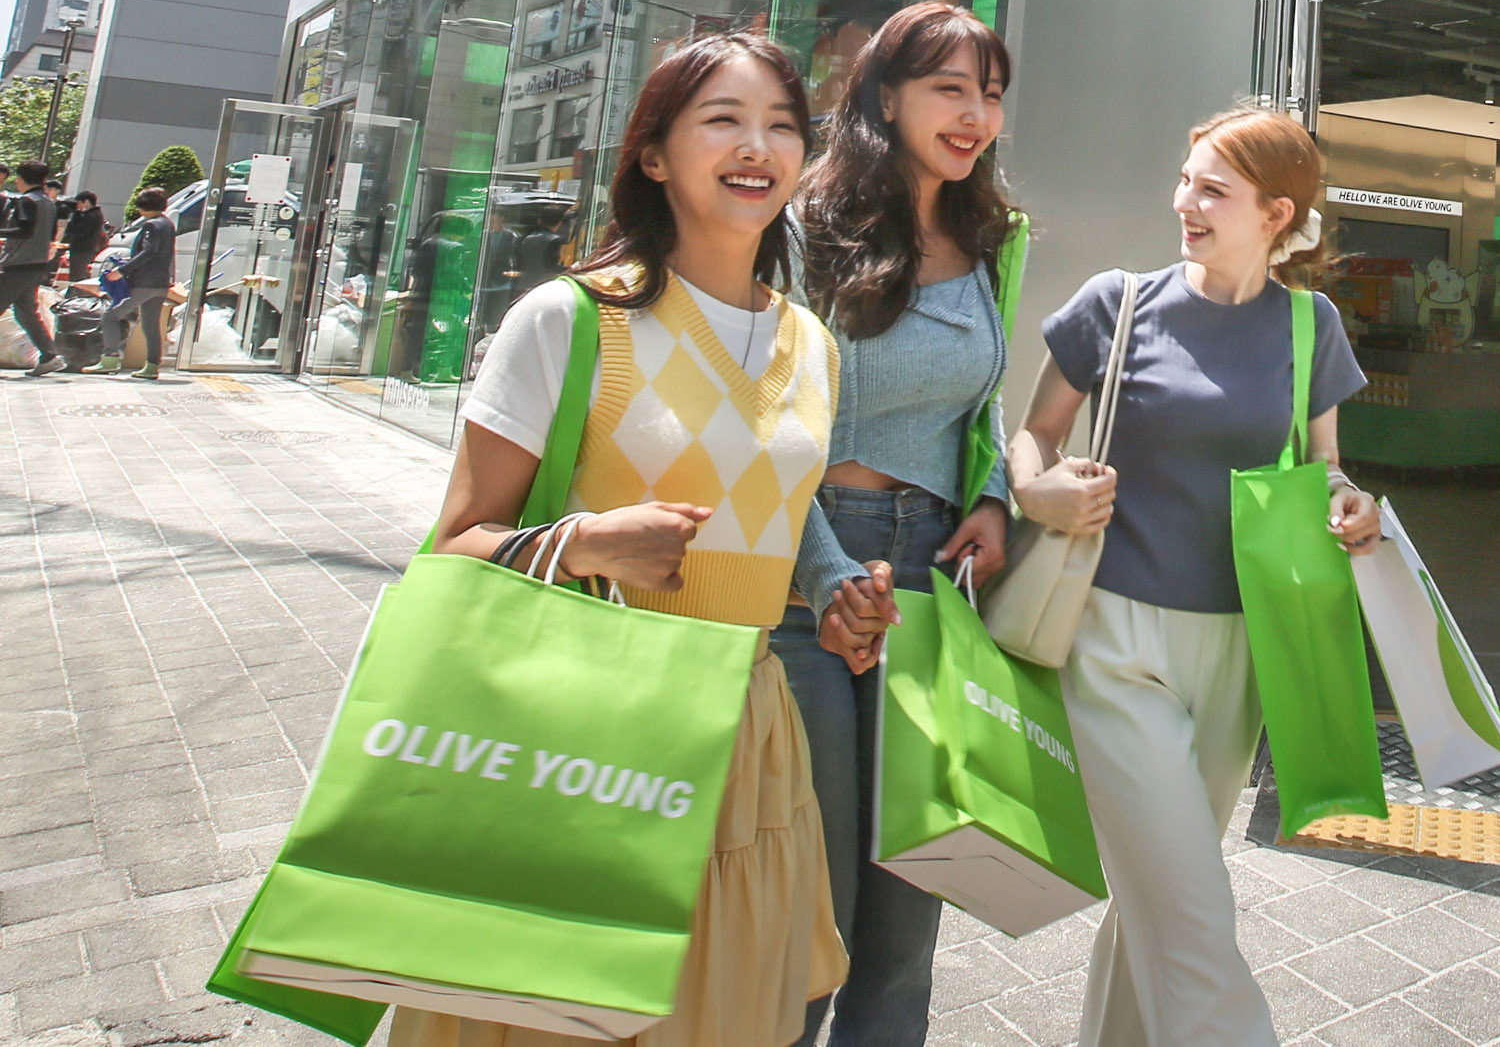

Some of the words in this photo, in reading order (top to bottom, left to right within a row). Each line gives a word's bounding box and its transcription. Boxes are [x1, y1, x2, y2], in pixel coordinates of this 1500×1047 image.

[1338, 191, 1367, 202] HELLO
[1368, 194, 1381, 204] WE
[1382, 196, 1398, 206] ARE
[1399, 198, 1423, 209] OLIVE
[1424, 202, 1452, 213] YOUNG
[362, 718, 522, 782] OLIVE
[528, 749, 696, 820] YOUNG
[963, 680, 1021, 733] OLIVE
[1022, 715, 1075, 774] YOUNG
